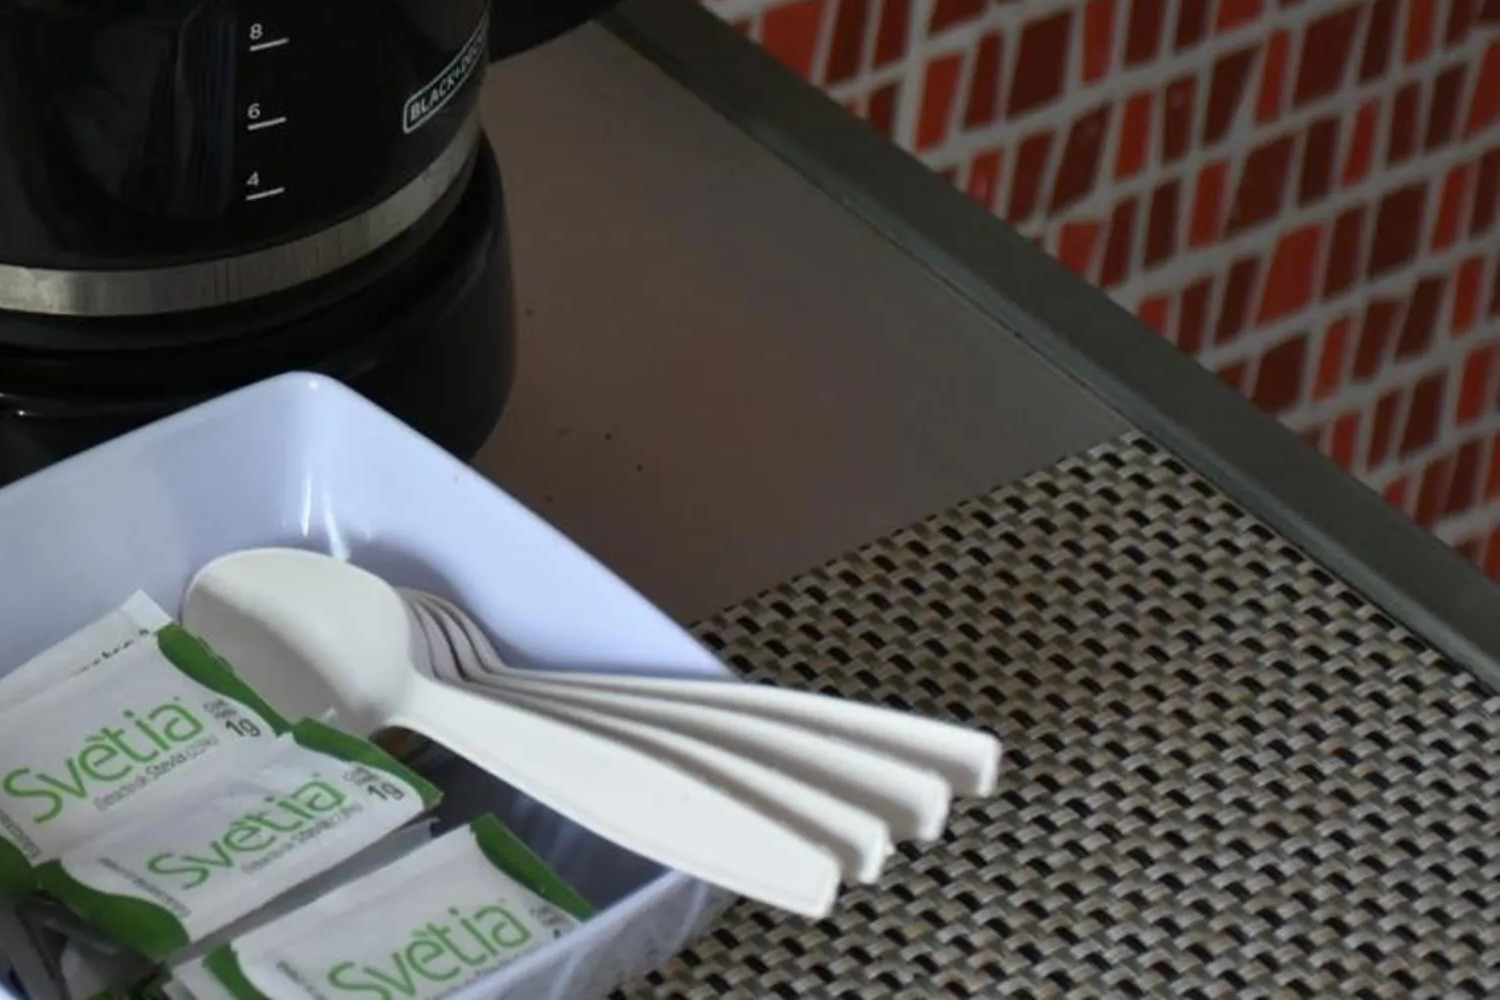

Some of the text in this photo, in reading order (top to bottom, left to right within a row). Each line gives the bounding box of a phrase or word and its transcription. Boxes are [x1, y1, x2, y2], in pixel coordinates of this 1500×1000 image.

[249, 22, 264, 40] 8
[247, 102, 261, 119] 6
[246, 171, 261, 188] 4
